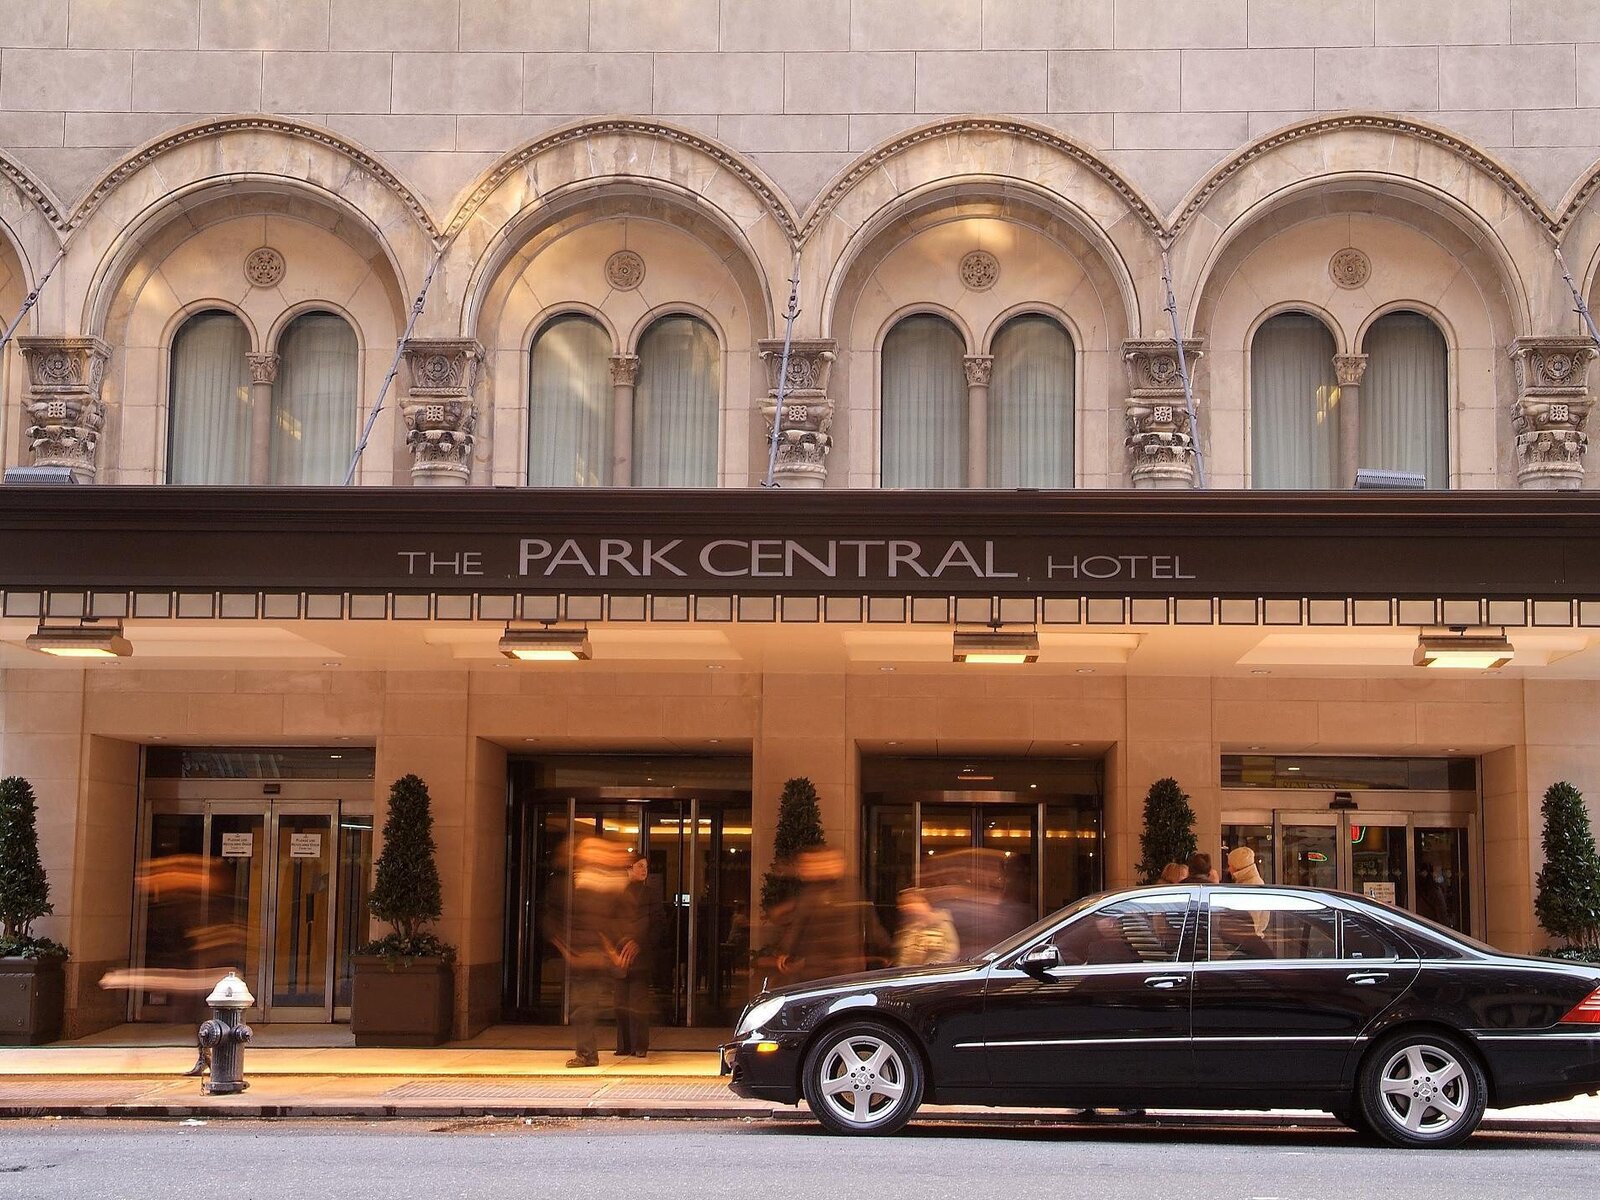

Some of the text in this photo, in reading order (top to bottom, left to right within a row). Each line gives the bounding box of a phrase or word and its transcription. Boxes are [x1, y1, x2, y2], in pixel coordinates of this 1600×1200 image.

[397, 538, 1196, 579] THE PARK CENTRAL HOTEL
